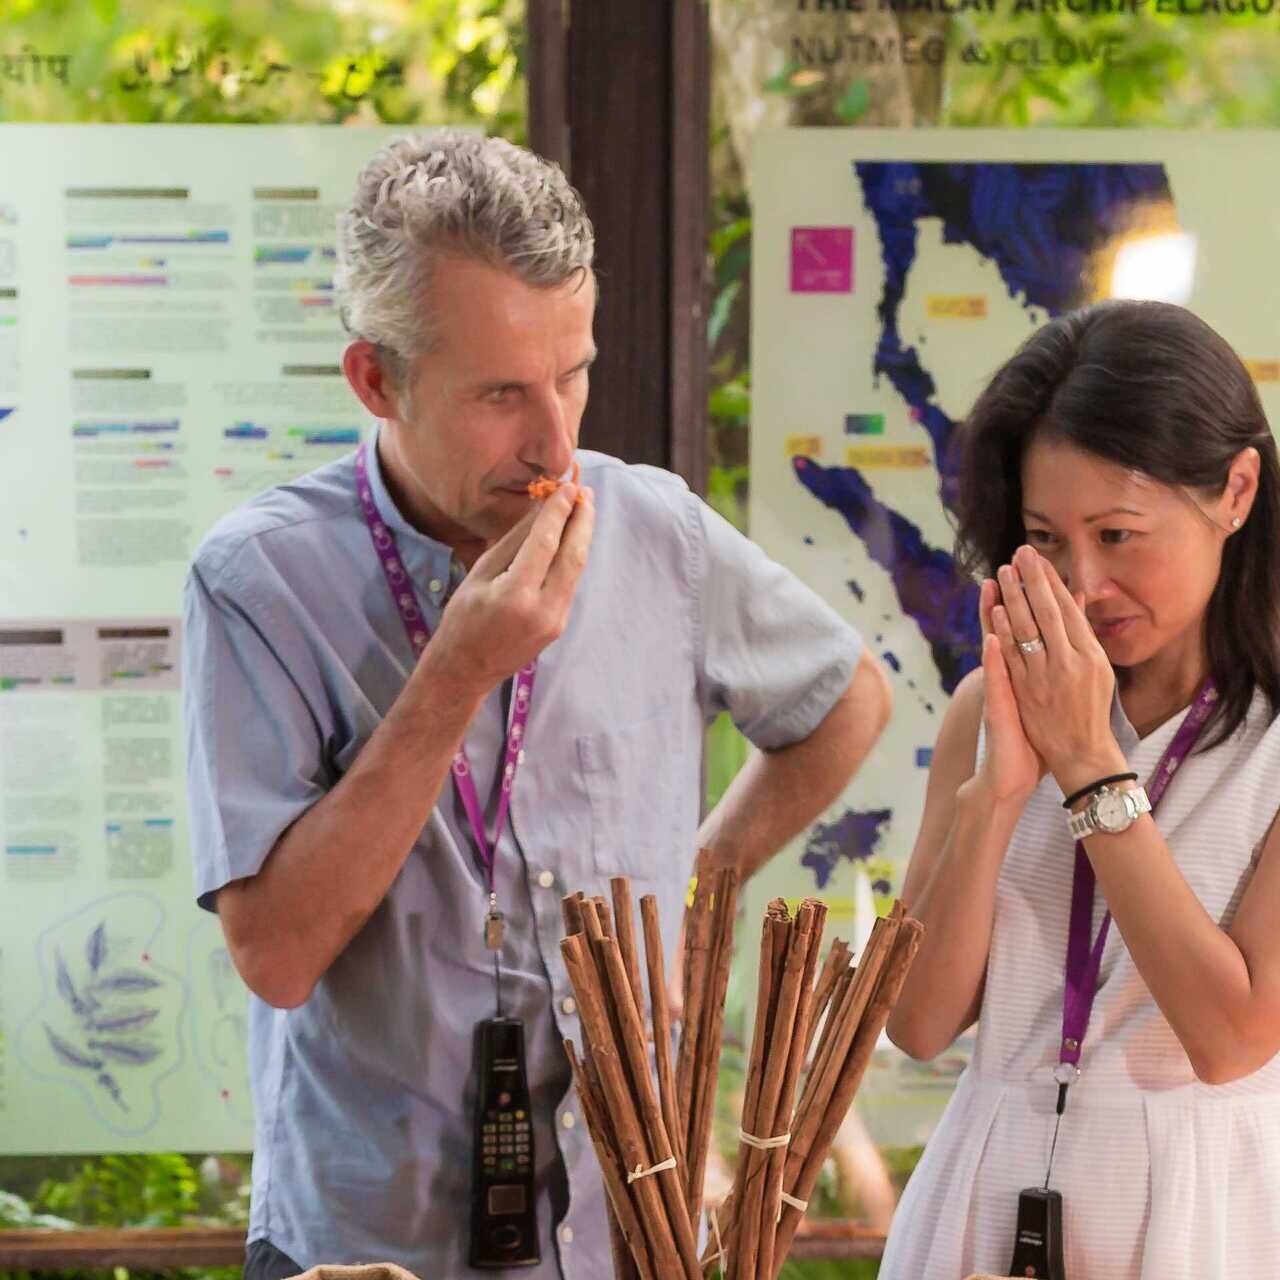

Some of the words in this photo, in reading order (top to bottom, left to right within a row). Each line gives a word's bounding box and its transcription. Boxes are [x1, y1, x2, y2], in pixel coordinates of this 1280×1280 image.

[792, 35, 946, 65] NUTMEG
[960, 38, 989, 65] &
[1005, 36, 1124, 65] CLOVE
